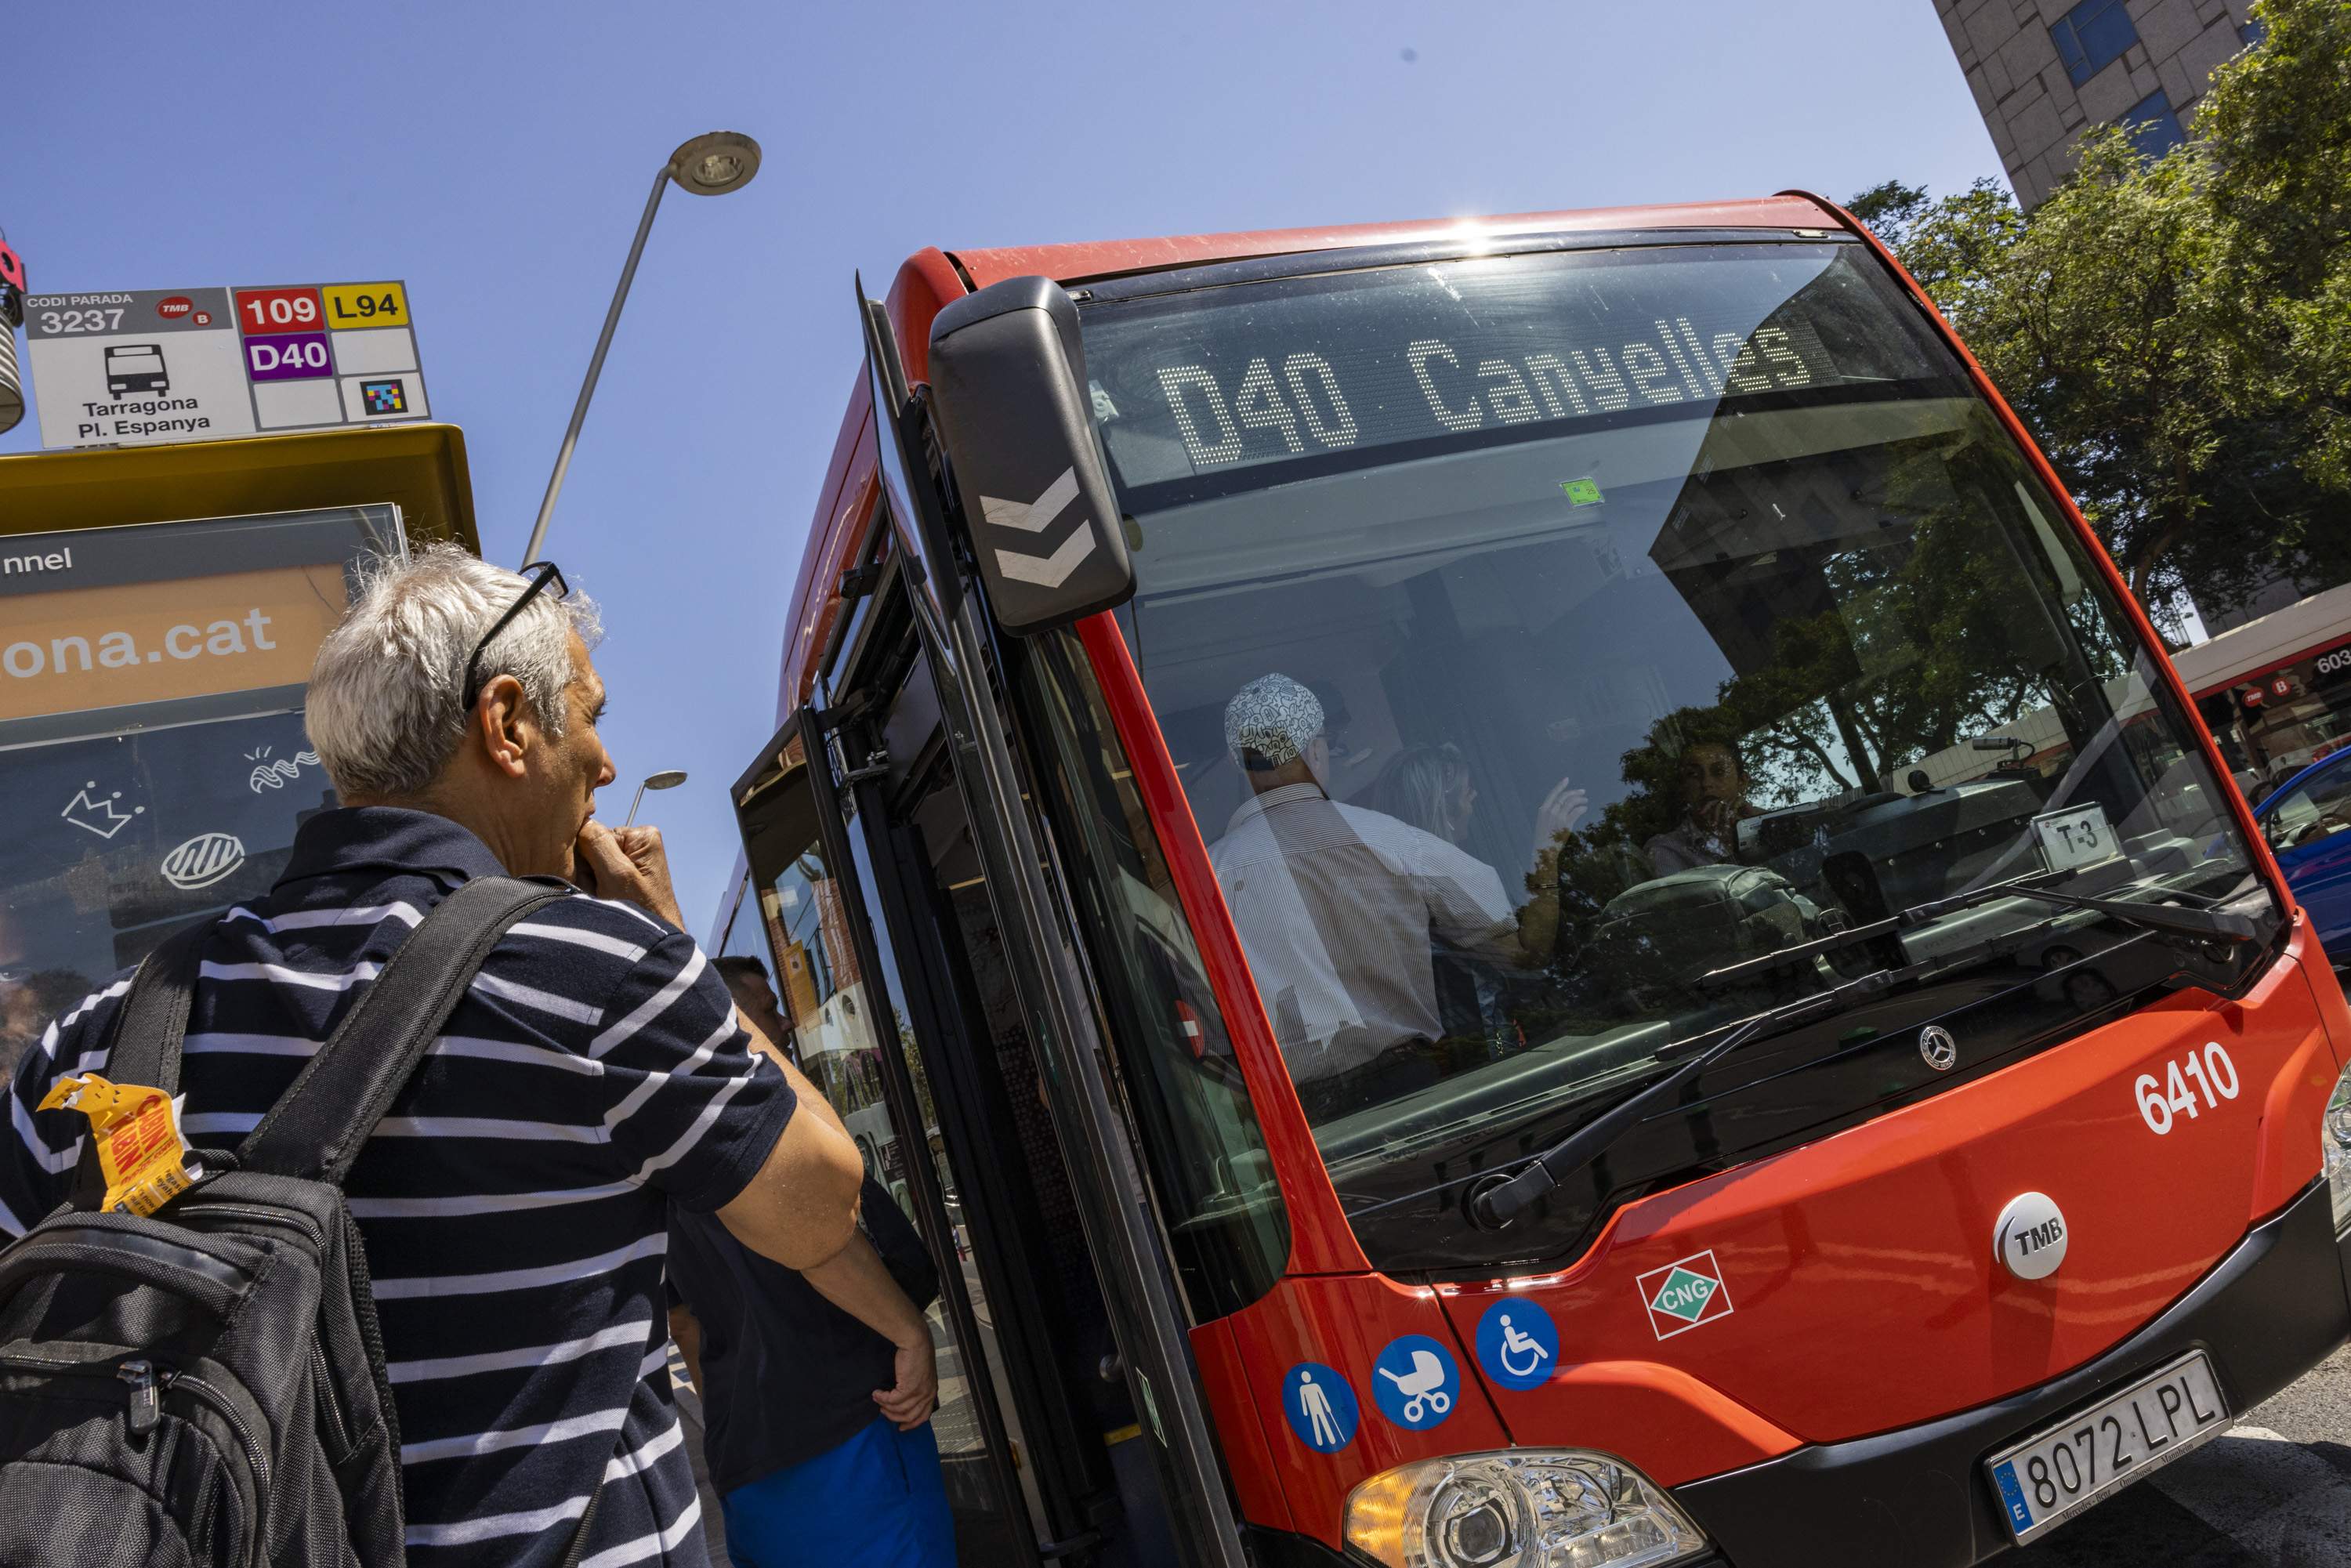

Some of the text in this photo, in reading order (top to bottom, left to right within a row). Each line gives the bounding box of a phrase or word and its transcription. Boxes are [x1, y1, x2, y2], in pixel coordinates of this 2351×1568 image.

[27, 295, 133, 308] CODI PARADA
[162, 304, 189, 313] TMB
[247, 297, 316, 324] 109
[334, 294, 398, 319] L94
[41, 309, 125, 334] 3237
[197, 314, 208, 324] B
[249, 342, 328, 371] D40
[1157, 317, 1811, 465] D40 Canyelles
[82, 398, 198, 417] Tarragona
[78, 417, 210, 438] Pl. Espanya
[0, 607, 276, 679] ona.cat
[2317, 648, 2351, 673] 603
[2247, 692, 2262, 702] TMB
[2275, 680, 2288, 693] B
[2056, 820, 2098, 853] T-3
[2135, 1041, 2239, 1135] 6410
[136, 1095, 168, 1153] CABIN
[2014, 1217, 2063, 1256] TMB
[1662, 1279, 1708, 1310] CNG
[2028, 1376, 2215, 1508] 8072 LPL
[2012, 1503, 2025, 1521] E
